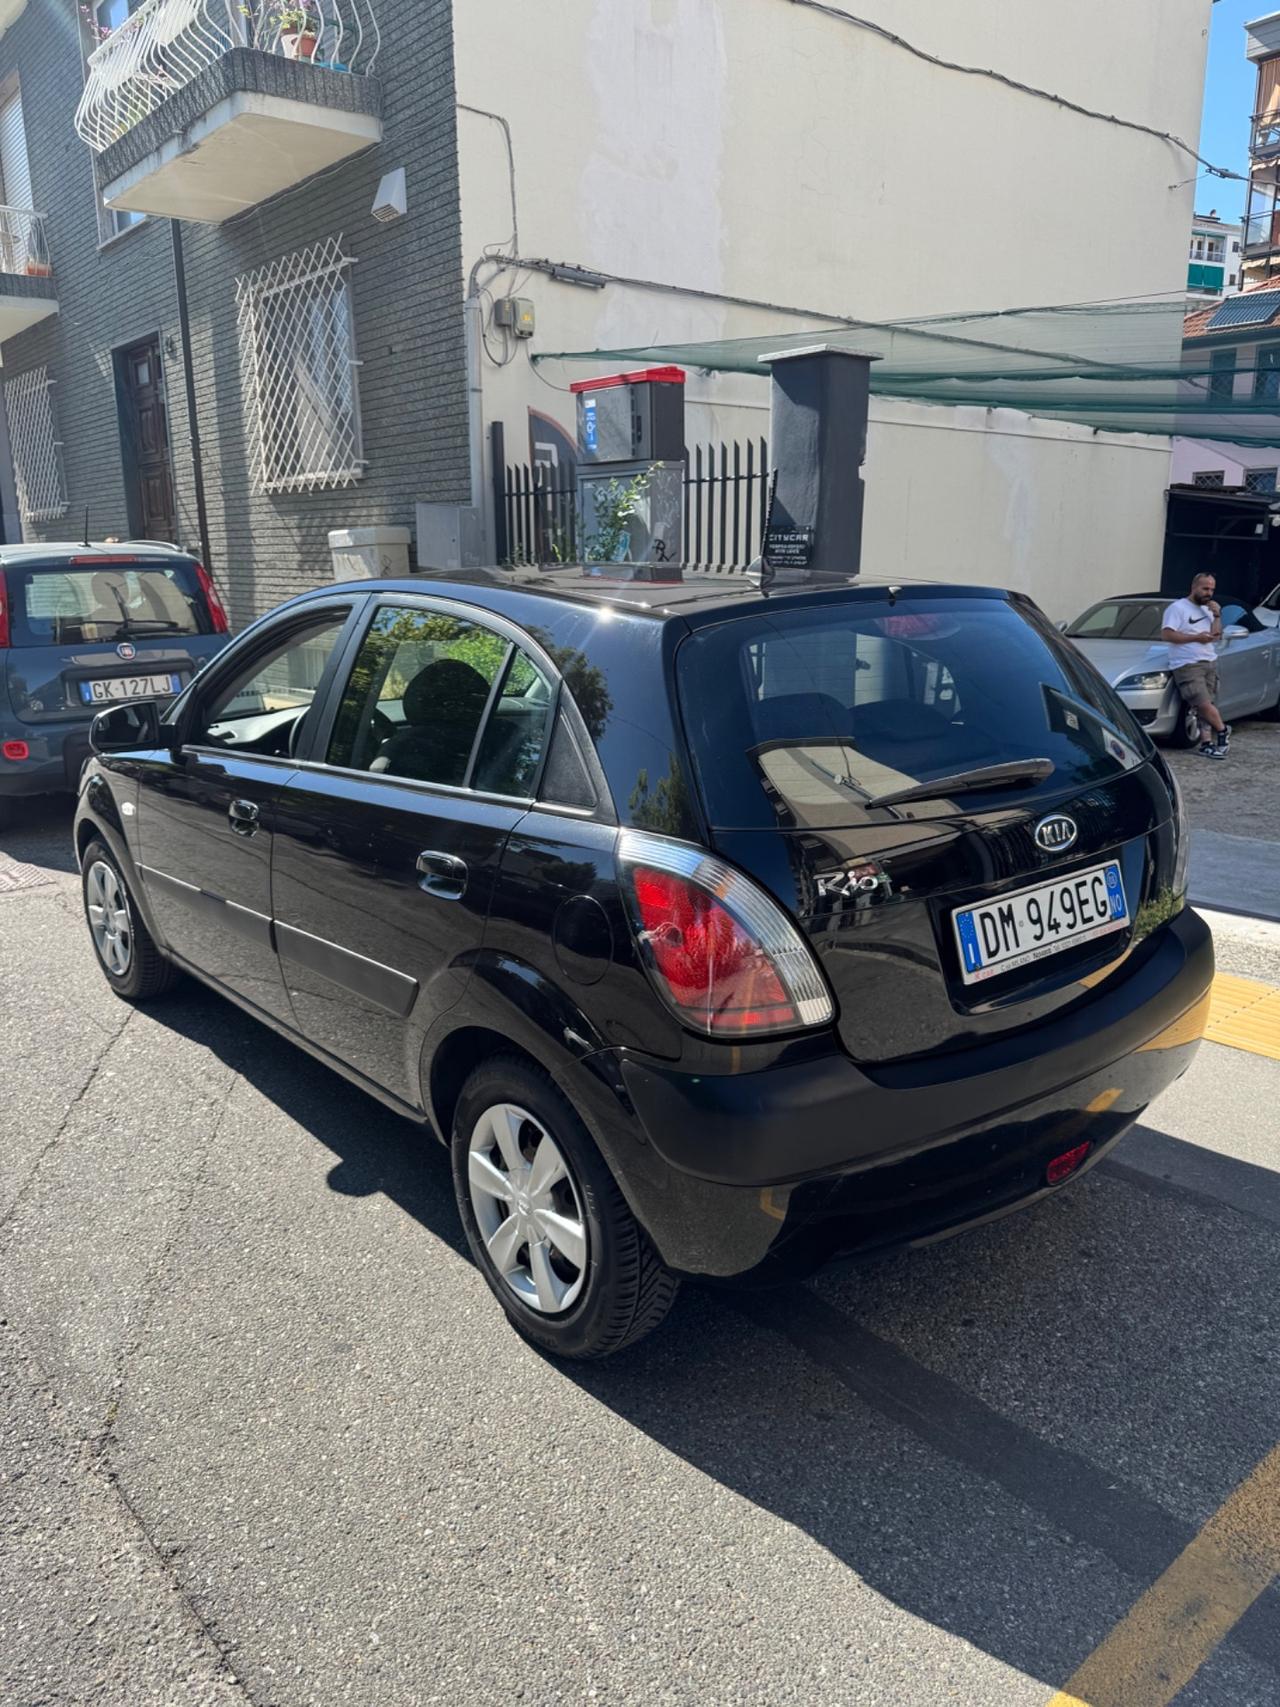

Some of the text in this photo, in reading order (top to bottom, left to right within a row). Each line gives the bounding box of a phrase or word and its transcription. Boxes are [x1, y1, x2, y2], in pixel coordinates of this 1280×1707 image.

[92, 676, 171, 699] GK 127LJ
[1041, 821, 1071, 845] KIA
[813, 870, 879, 896] Rio
[979, 876, 1108, 959] DM 949EG
